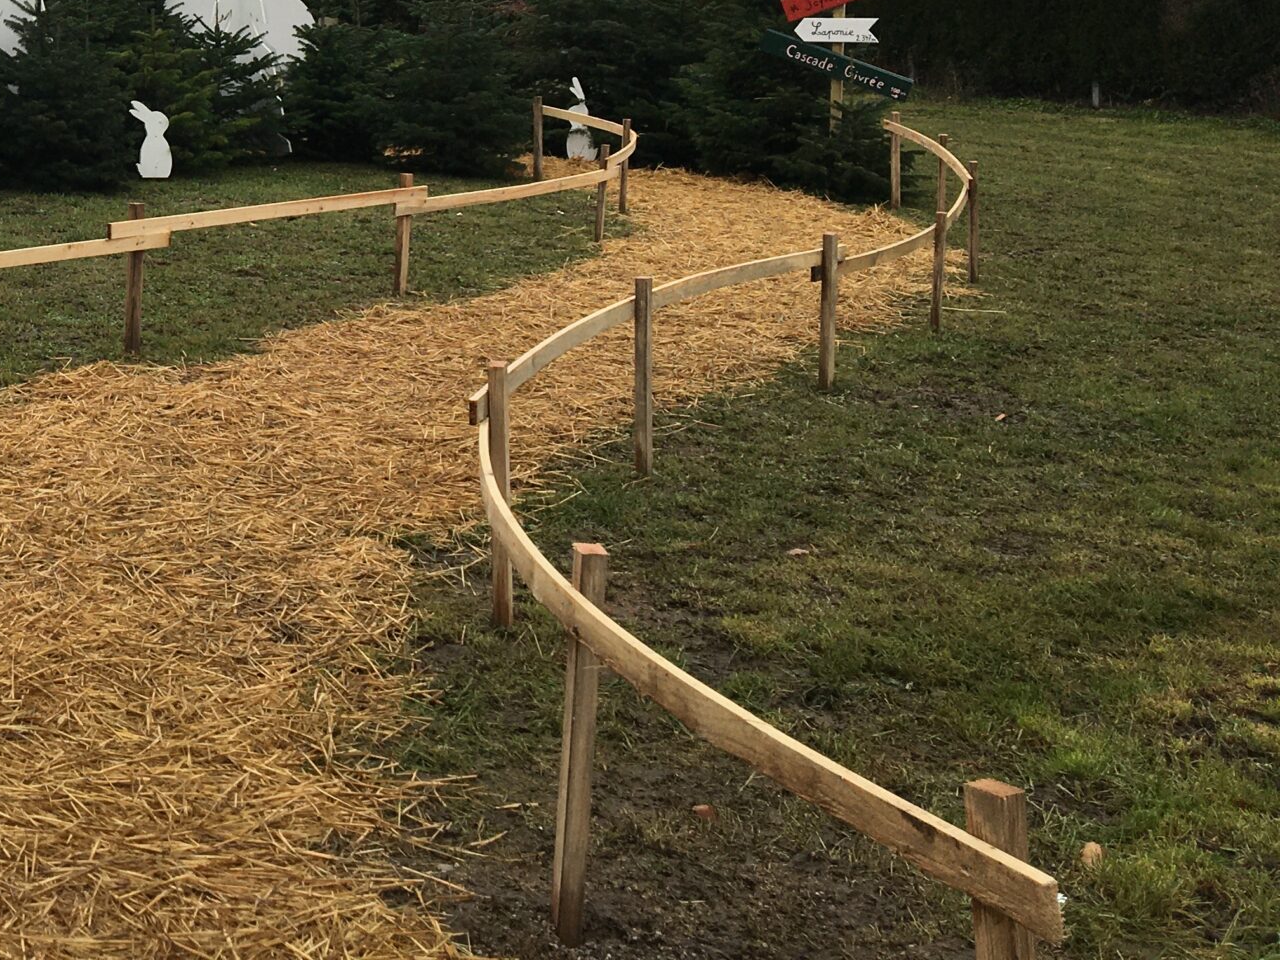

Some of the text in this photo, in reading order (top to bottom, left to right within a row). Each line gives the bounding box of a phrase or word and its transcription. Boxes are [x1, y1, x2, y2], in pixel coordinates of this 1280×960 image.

[811, 21, 855, 39] Laponie
[786, 44, 884, 89] Cascade Givrée
